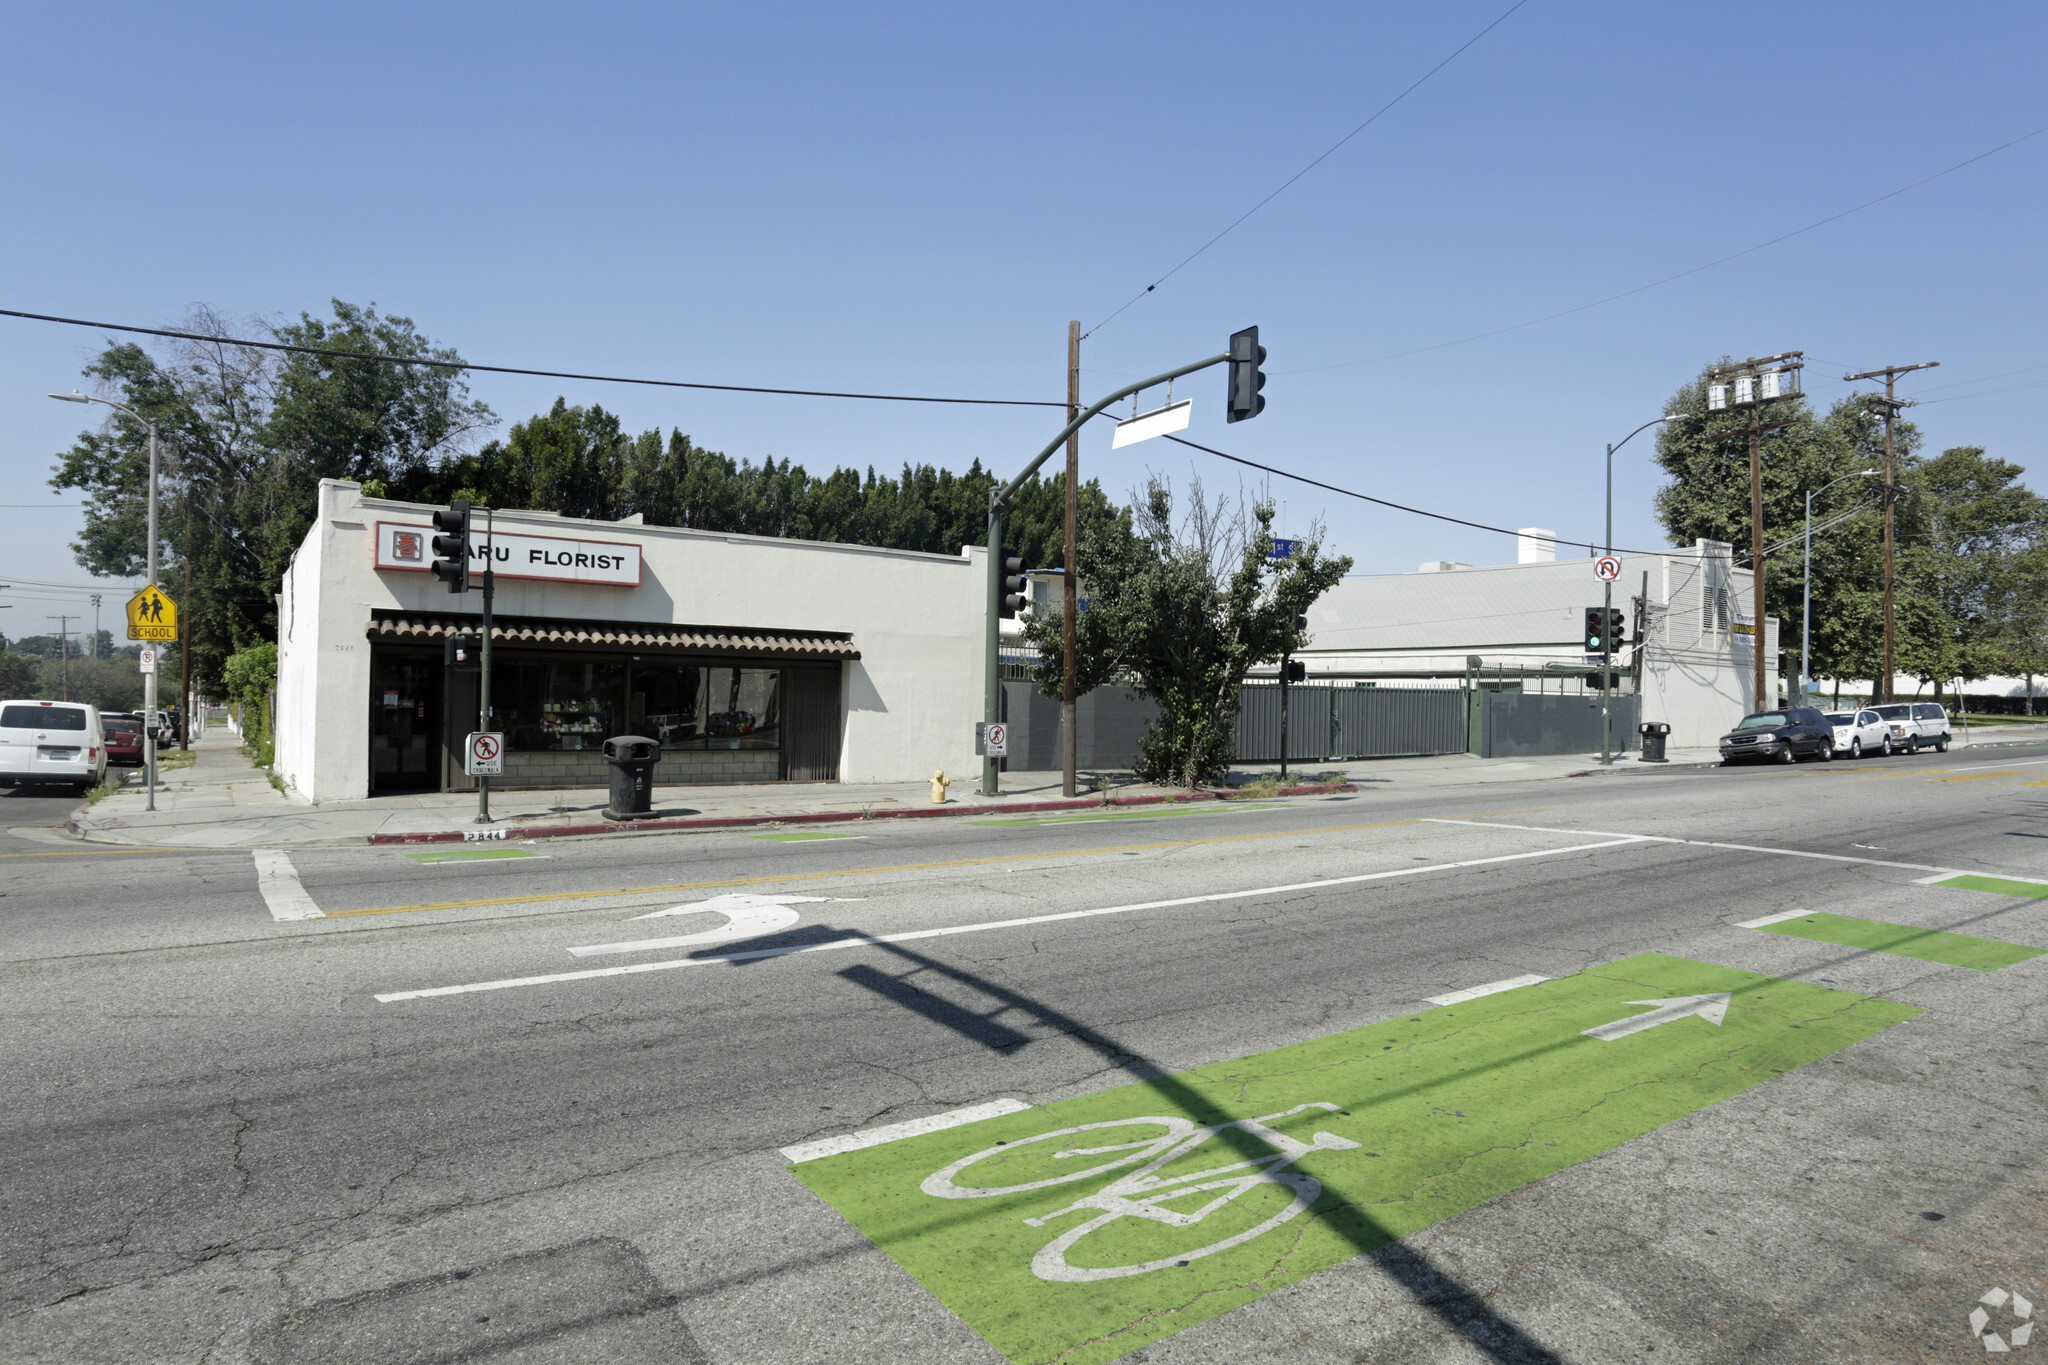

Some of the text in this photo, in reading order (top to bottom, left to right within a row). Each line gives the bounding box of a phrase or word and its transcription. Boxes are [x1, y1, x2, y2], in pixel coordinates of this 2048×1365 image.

[468, 544, 625, 570] ARU FLORIST
[131, 627, 173, 638] SCHOOL
[468, 832, 500, 841] 2844
